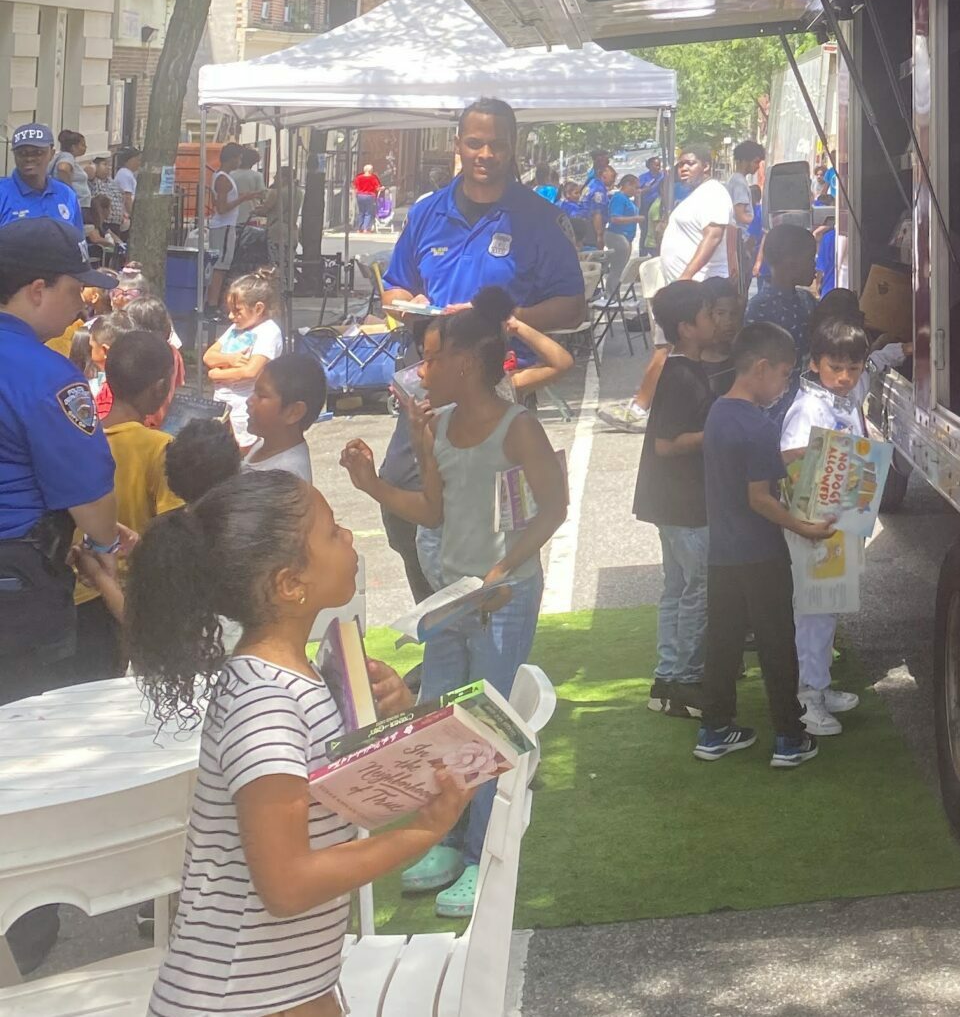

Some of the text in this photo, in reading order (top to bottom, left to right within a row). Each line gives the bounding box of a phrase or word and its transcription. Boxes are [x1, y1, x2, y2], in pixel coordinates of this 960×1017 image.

[14, 129, 44, 143] NYPD
[819, 446, 838, 506] ALLOWED!
[828, 450, 848, 504] NO DOGS
